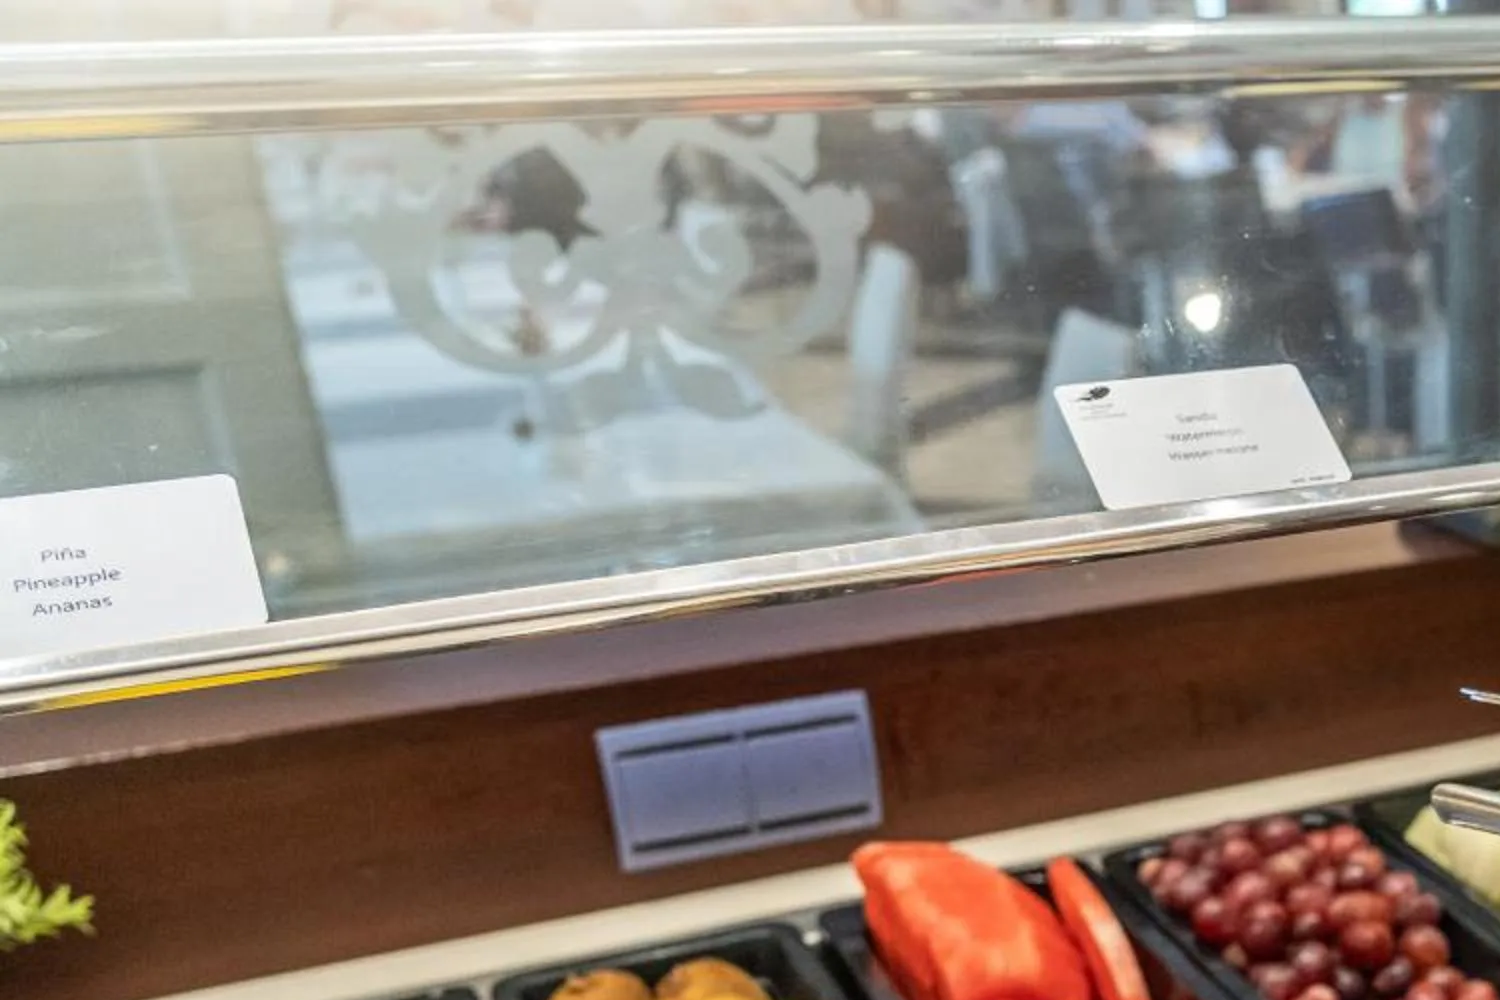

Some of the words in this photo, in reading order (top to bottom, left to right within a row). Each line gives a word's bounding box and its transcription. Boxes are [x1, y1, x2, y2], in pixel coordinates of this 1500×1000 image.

[40, 547, 87, 562] Piña
[13, 567, 121, 592] Pineapple
[32, 596, 113, 616] Ananas
